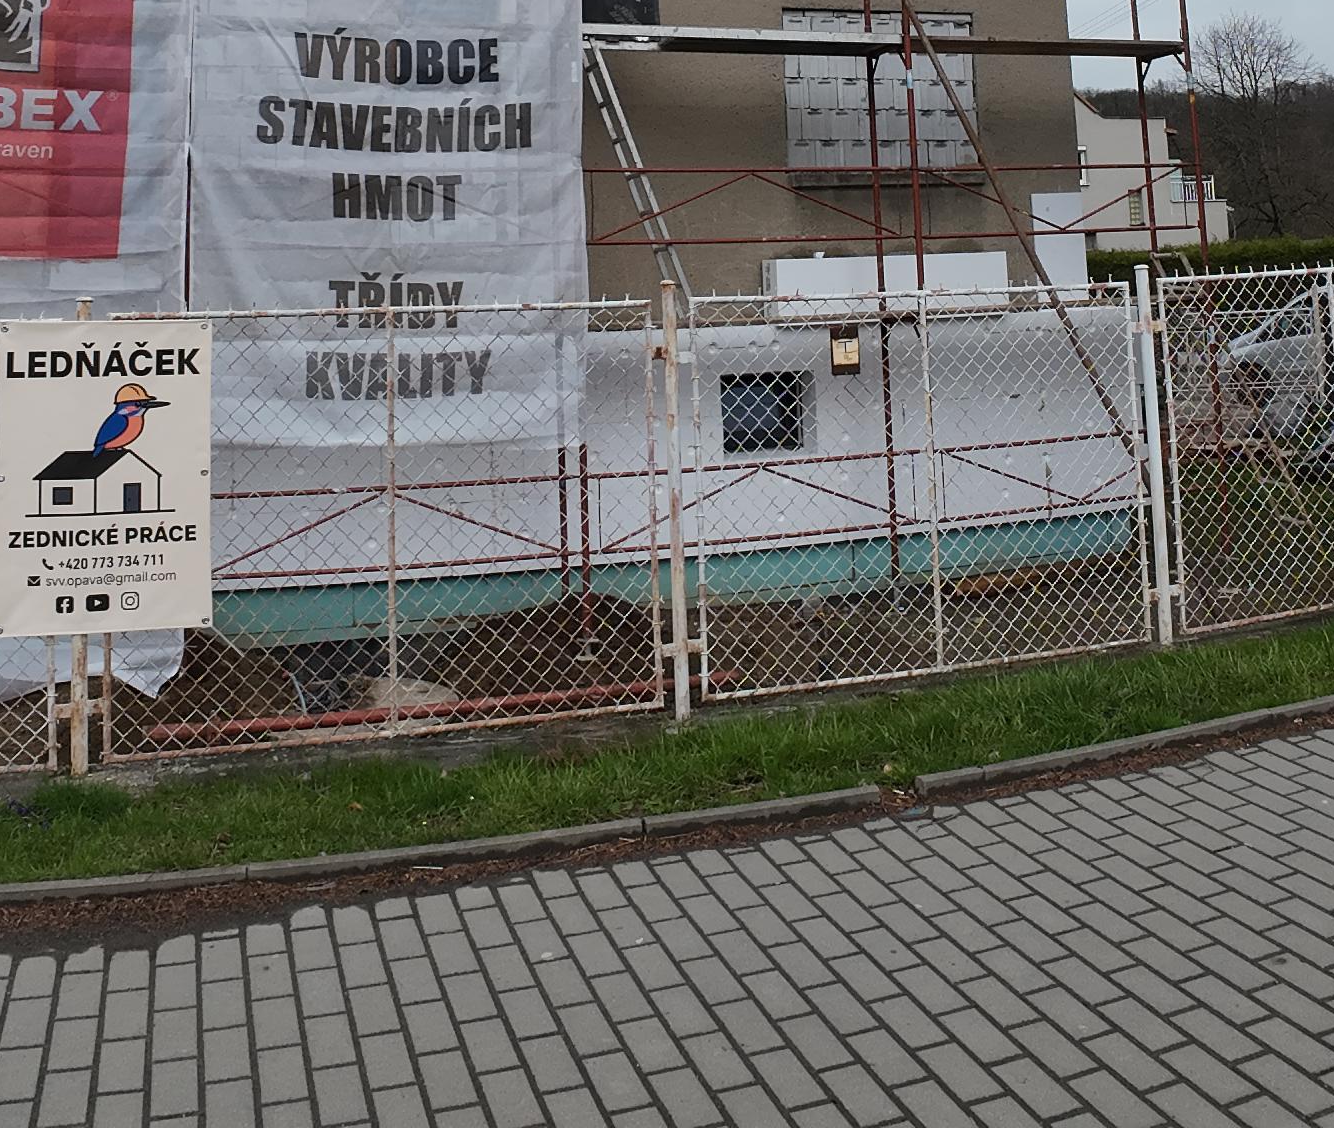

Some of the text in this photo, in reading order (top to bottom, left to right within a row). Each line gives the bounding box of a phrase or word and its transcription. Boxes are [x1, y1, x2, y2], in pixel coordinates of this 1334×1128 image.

[294, 27, 499, 85] VÝROBCE
[256, 95, 532, 154] STAVEBNÍCH
[332, 172, 462, 222] HMOT
[328, 272, 464, 329] TŘÍDY
[6, 341, 200, 379] LEDŇÁČEK
[305, 350, 492, 401] KVALITY
[8, 521, 197, 549] ZEDNICKÉ PRÁCE
[45, 571, 177, 588] svv.opava@gmail.com
[58, 553, 165, 570] +420 773 734 711
